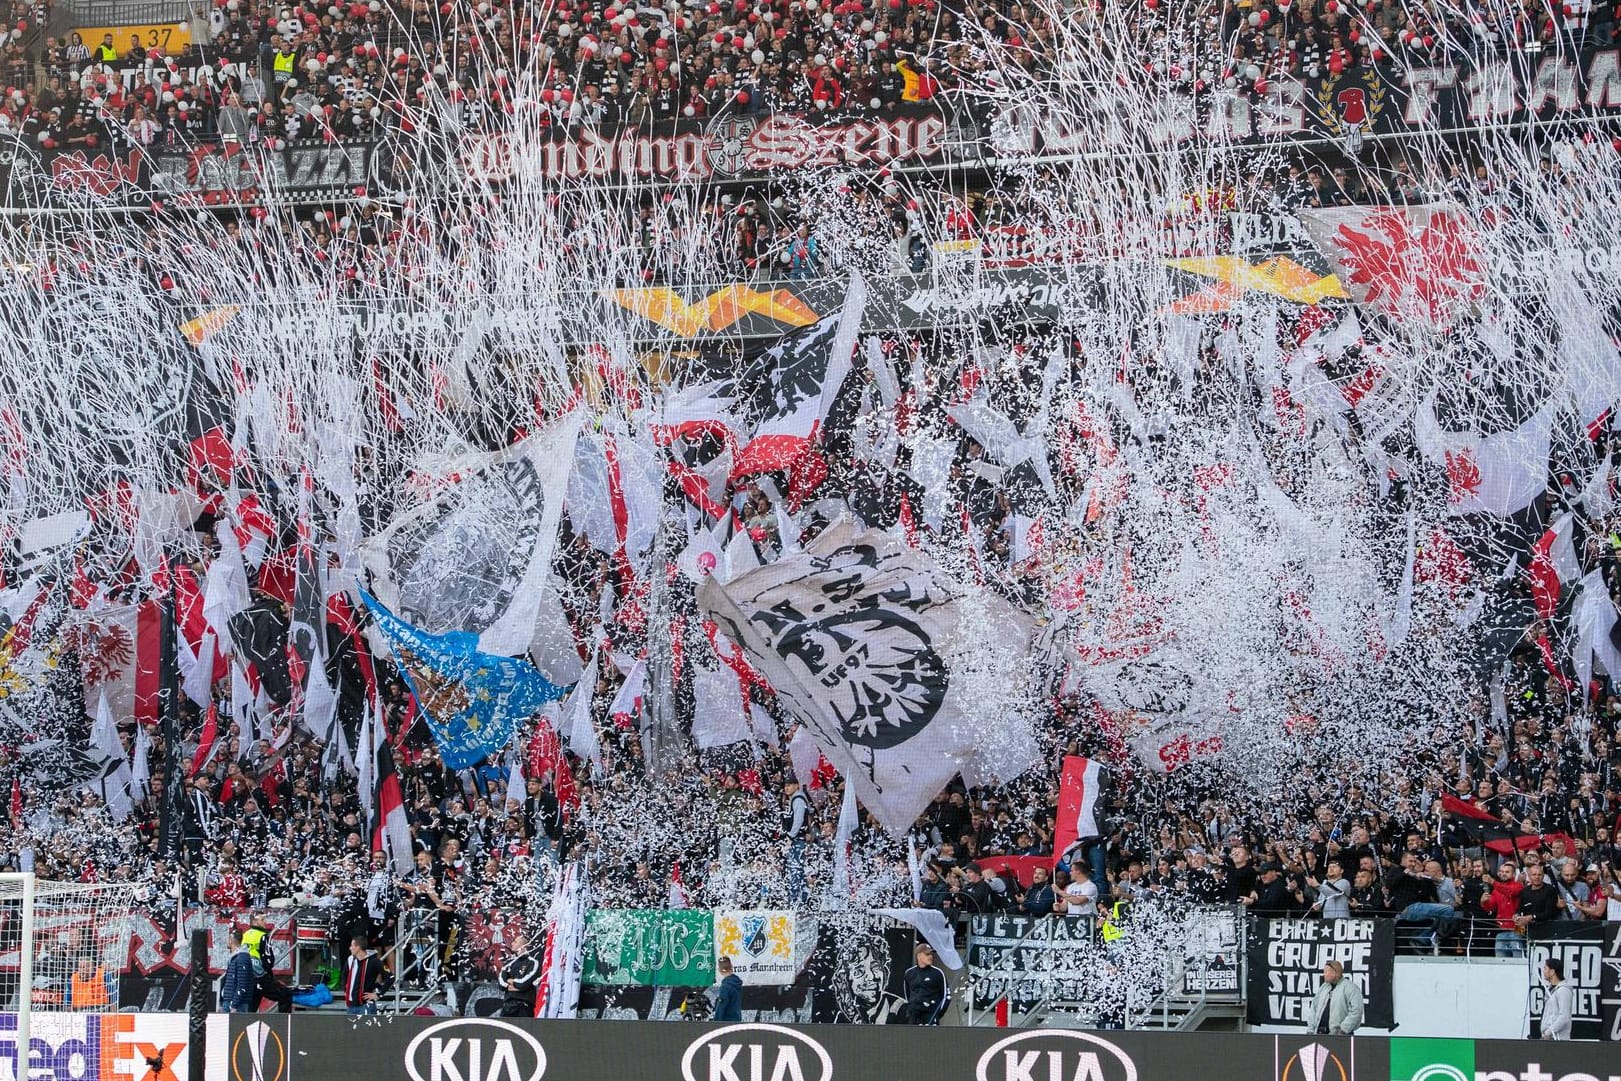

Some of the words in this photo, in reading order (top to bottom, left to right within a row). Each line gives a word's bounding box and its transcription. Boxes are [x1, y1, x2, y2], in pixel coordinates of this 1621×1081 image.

[148, 28, 172, 47] 37
[462, 125, 712, 182] nding
[744, 112, 945, 171] Szene
[820, 642, 870, 688] UF97
[972, 915, 1088, 940] ULTRAS
[1268, 920, 1320, 940] EHRE
[1333, 919, 1374, 941] DER
[631, 920, 714, 971] 1964
[1268, 942, 1372, 971] GRUPPE
[1268, 970, 1370, 995] STADN
[1268, 994, 1370, 1024] VER
[1530, 988, 1601, 1016] GIET
[429, 1038, 518, 1081] KIA
[708, 1043, 803, 1081] KIA
[1004, 1050, 1105, 1081] KIA
